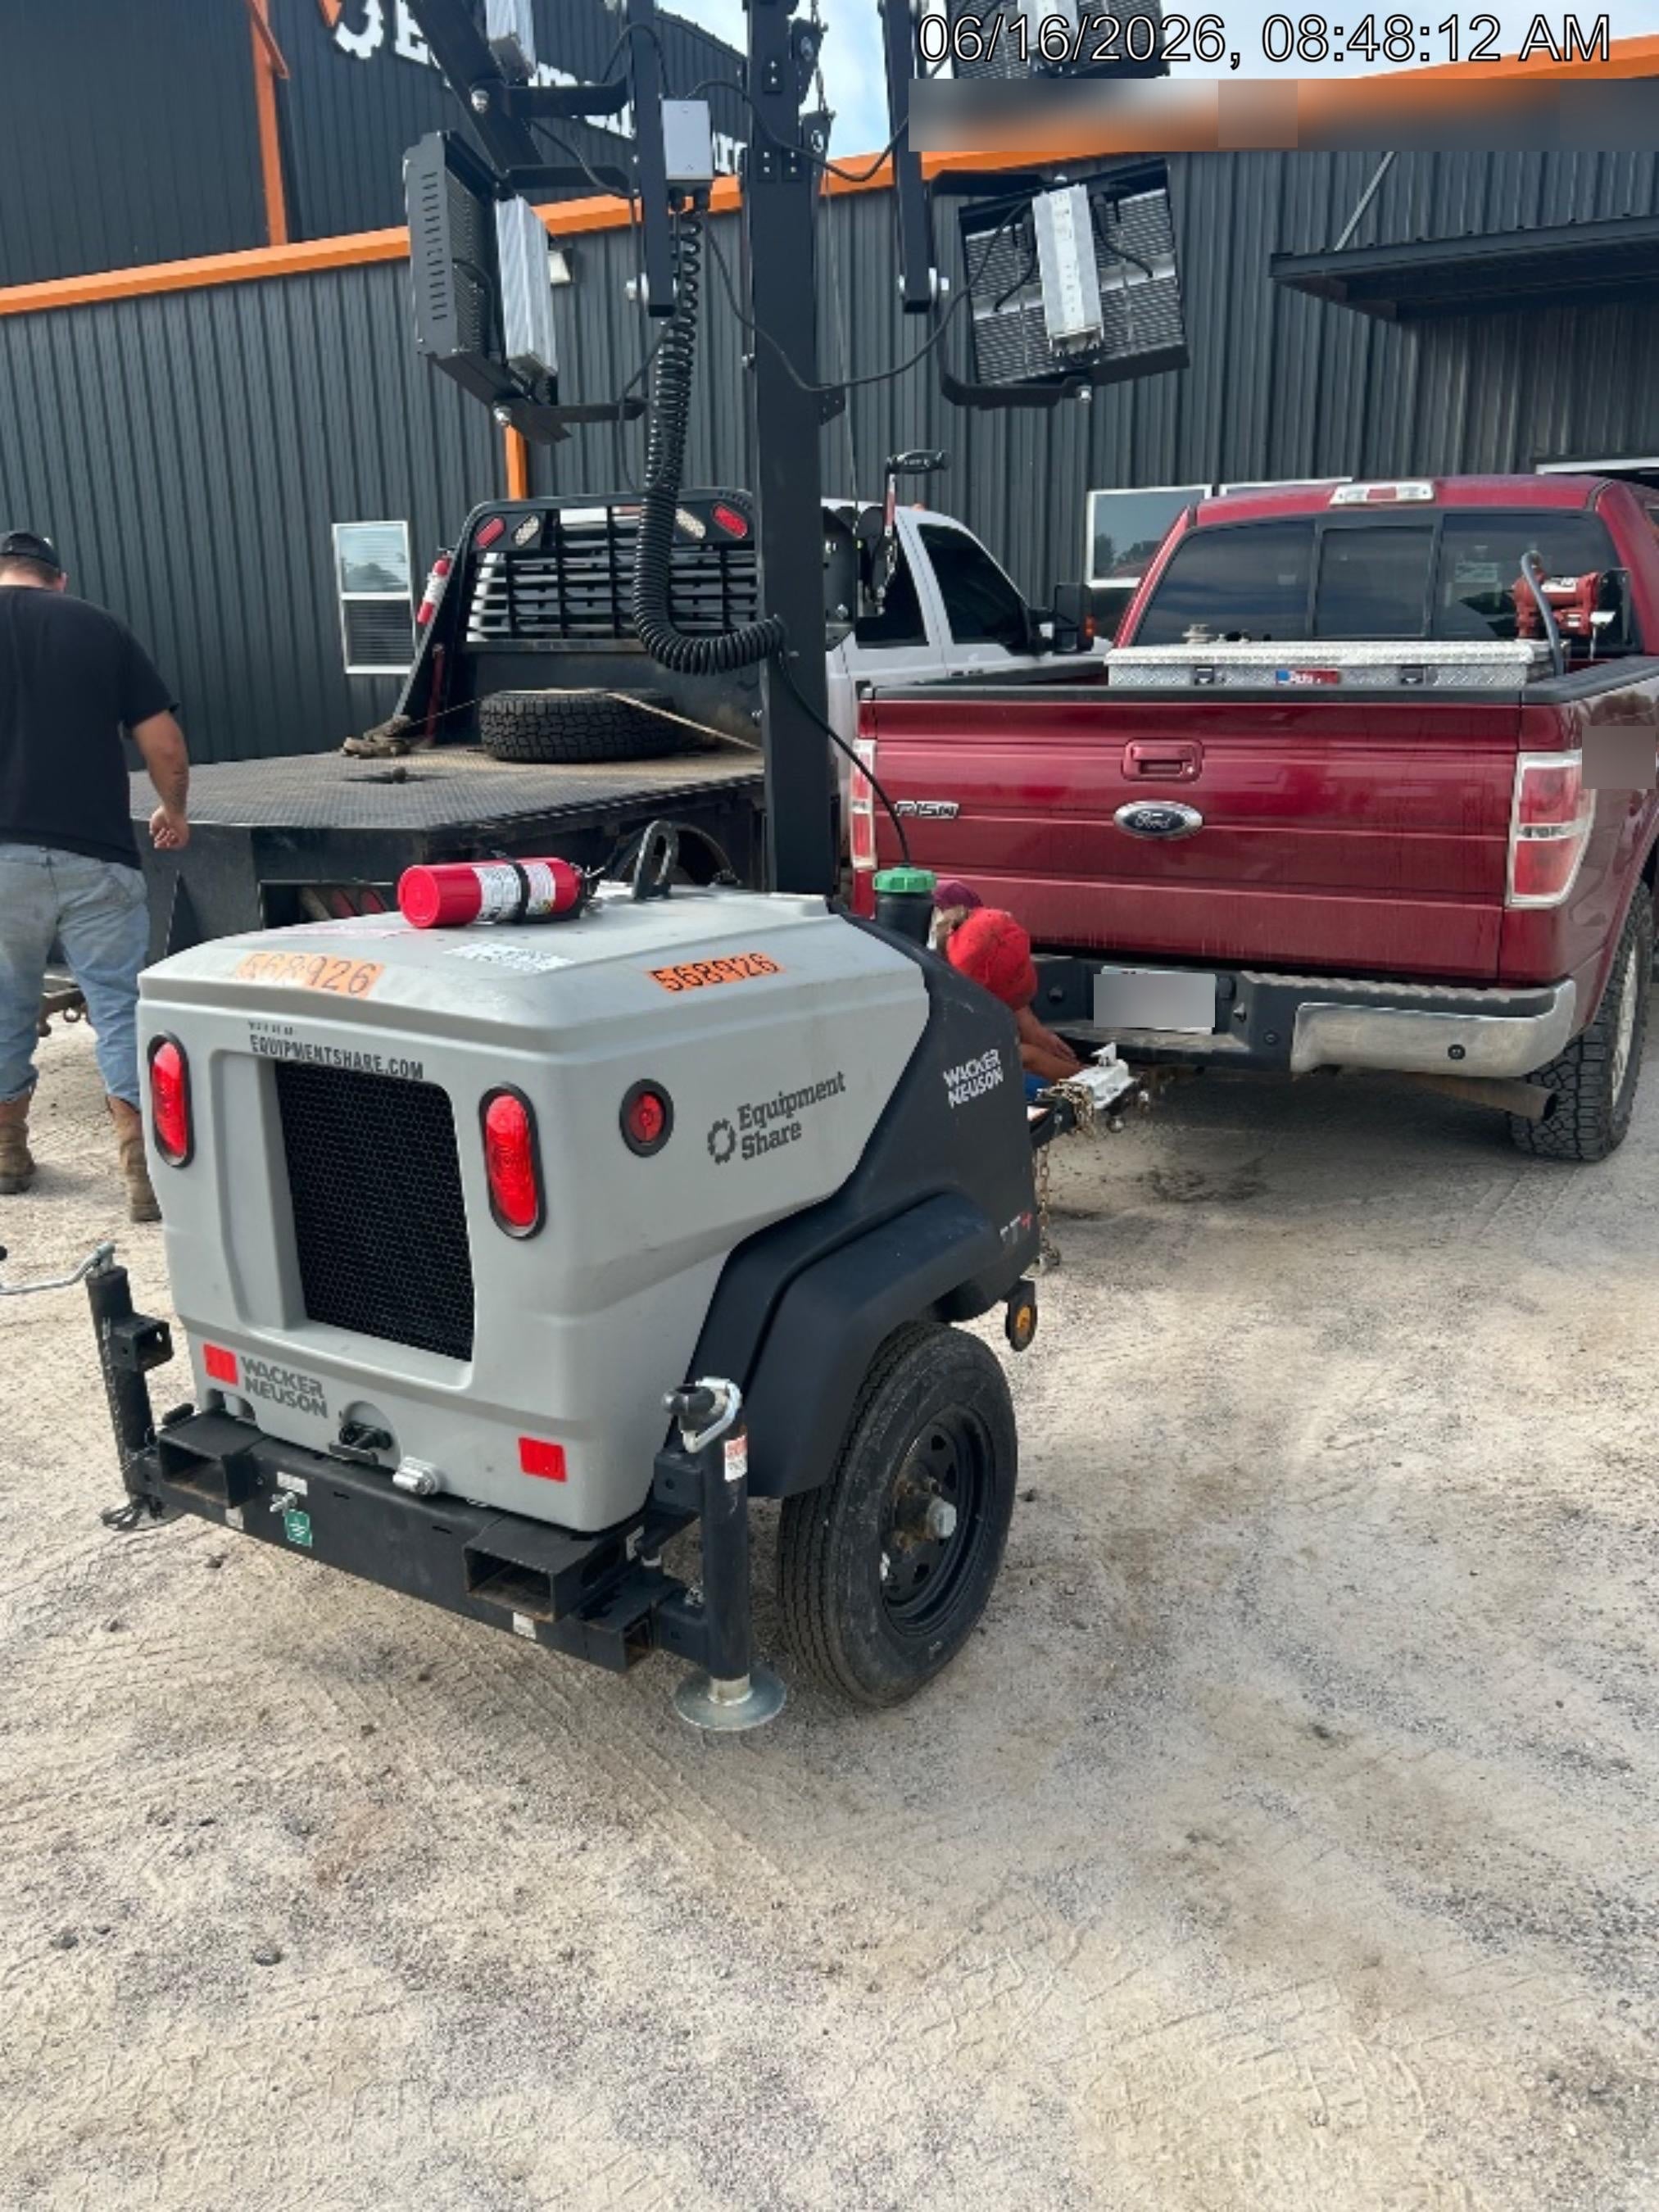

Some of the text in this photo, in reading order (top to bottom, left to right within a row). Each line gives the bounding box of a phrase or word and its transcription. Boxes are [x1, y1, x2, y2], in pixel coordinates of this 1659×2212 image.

[650, 952, 778, 991] 568926
[249, 1034, 424, 1081] EQUIPMENTSHARE.COM
[943, 1049, 1000, 1088] WACKER
[737, 1070, 846, 1131] Equipment
[949, 1066, 1004, 1109] NEUSON
[741, 1120, 802, 1160] Share
[240, 1356, 324, 1399] WACKER
[245, 1376, 329, 1419] NEUSON
